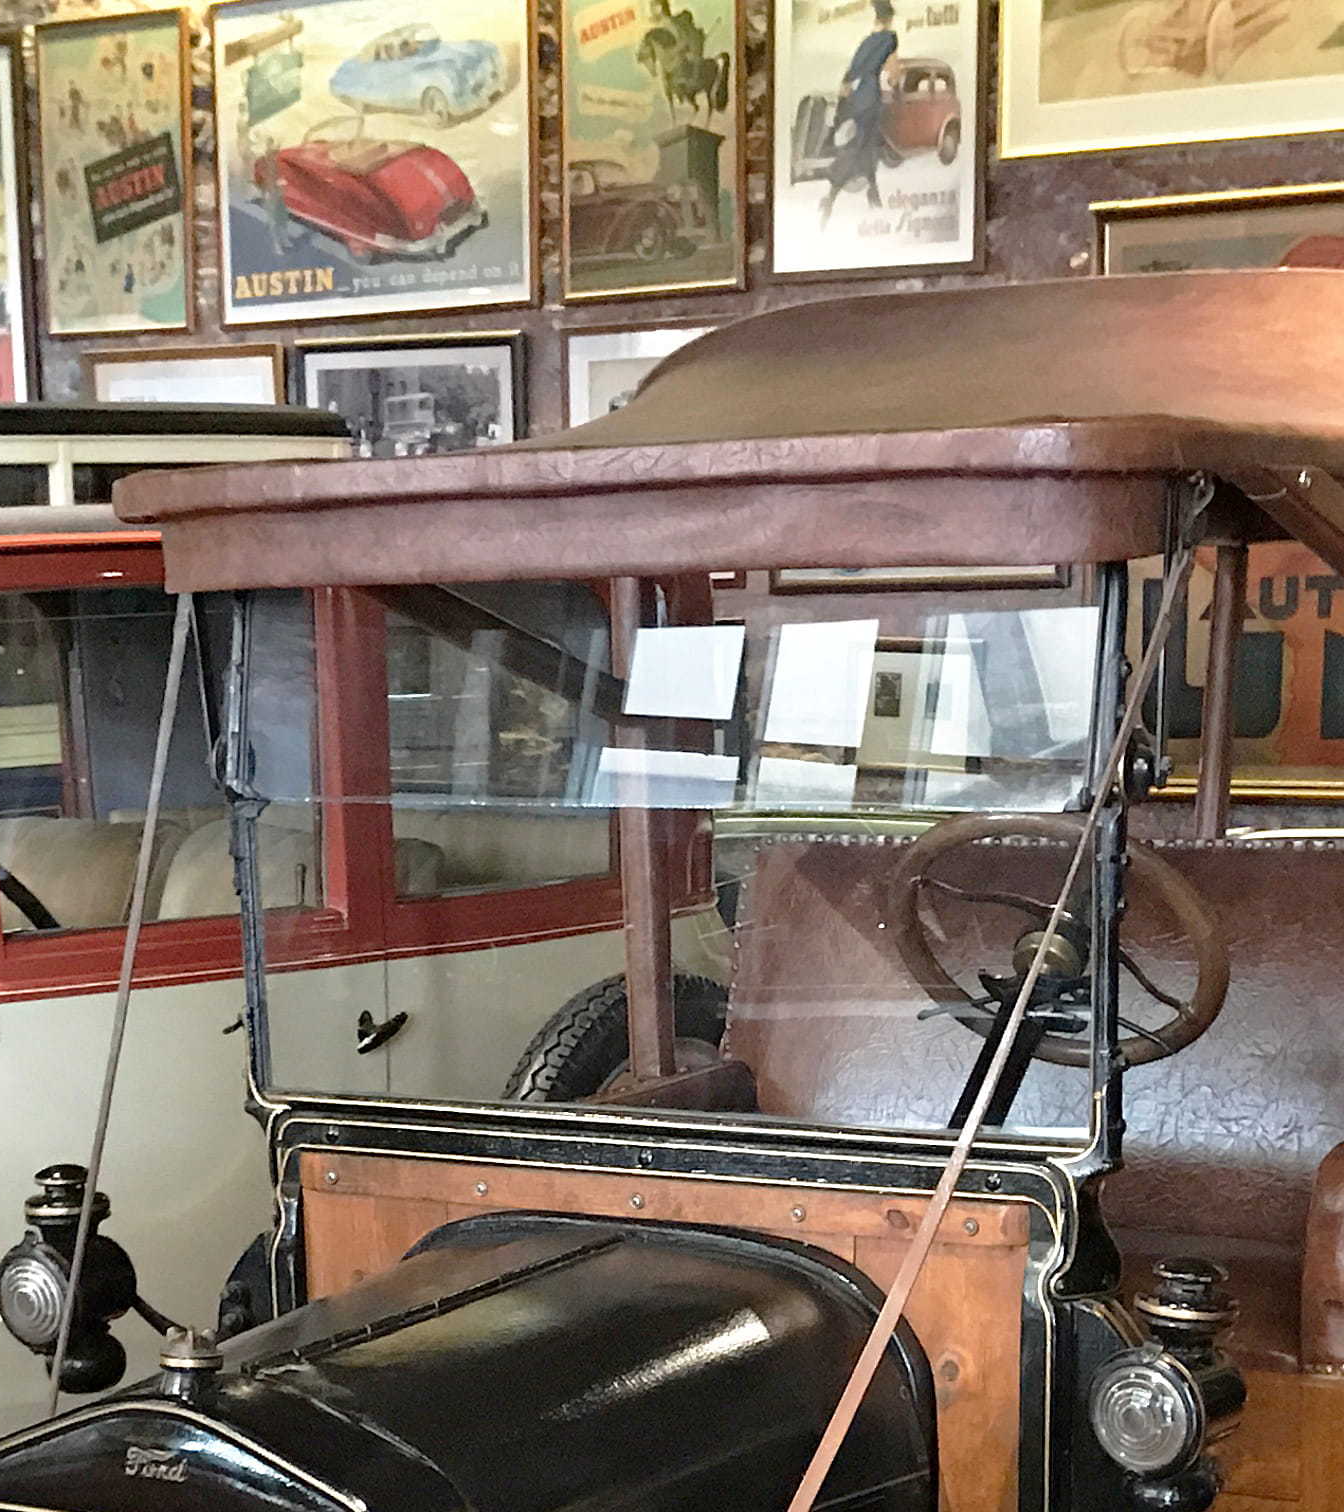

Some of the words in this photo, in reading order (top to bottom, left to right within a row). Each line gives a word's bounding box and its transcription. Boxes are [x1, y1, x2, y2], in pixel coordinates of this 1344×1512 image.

[579, 8, 636, 45] AUSTIN
[234, 266, 335, 299] AUSTIN
[422, 265, 478, 287] depend
[124, 1445, 189, 1484] Ford
